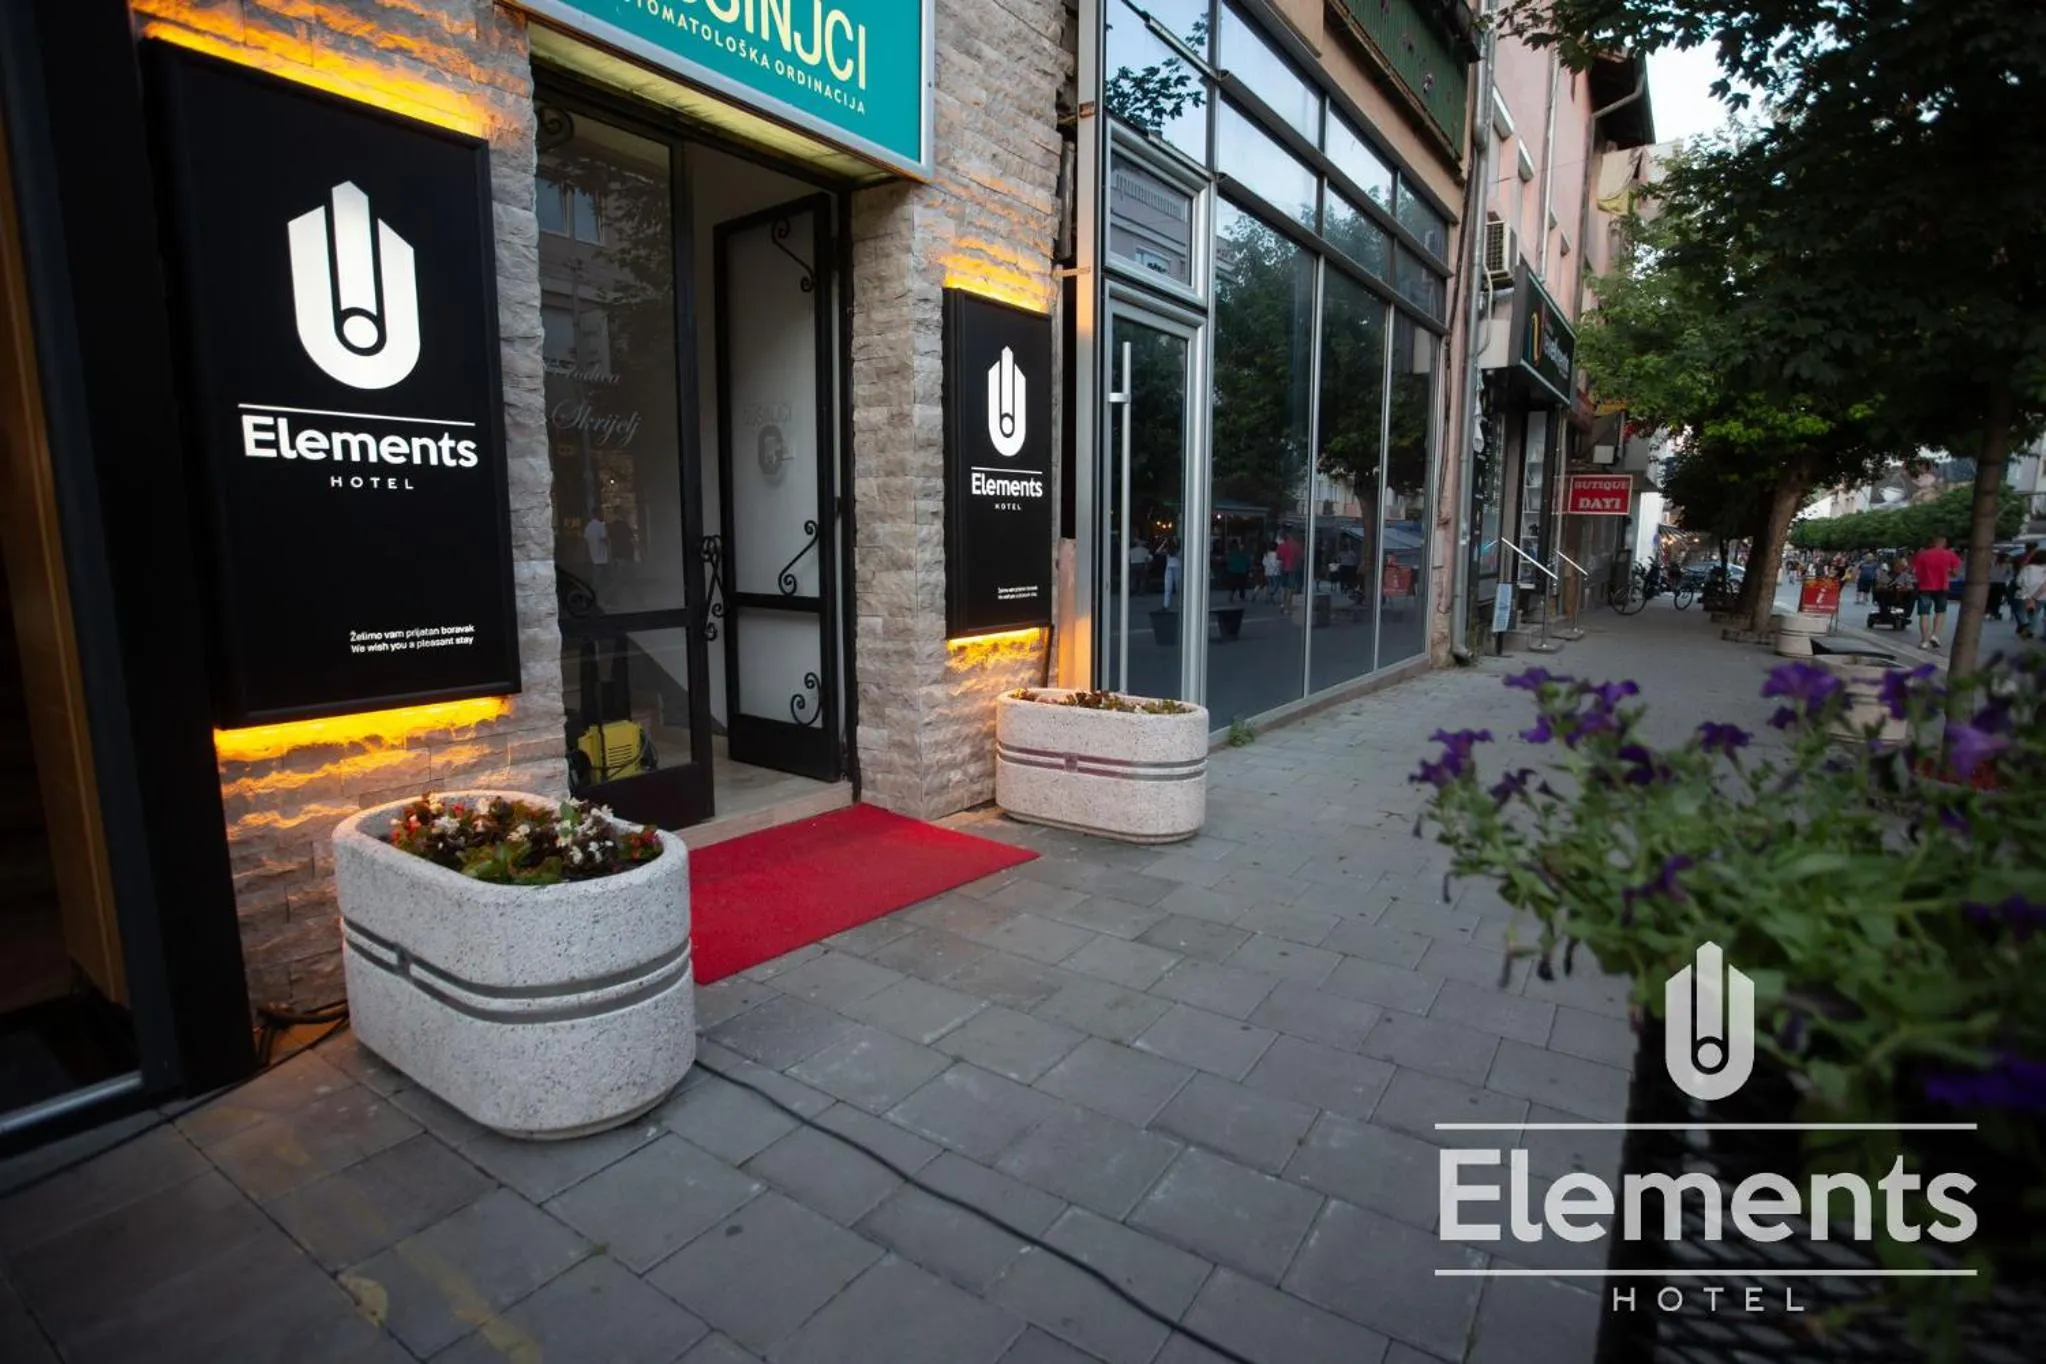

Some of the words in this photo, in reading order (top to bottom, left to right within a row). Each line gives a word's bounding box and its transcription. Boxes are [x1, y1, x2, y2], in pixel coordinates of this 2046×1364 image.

[624, 0, 770, 69] OMATOLOŠKA
[774, 60, 866, 115] ORDINACIJA
[681, 0, 866, 90] NJCI
[241, 414, 479, 468] Elements
[330, 476, 414, 490] HOTEL
[971, 472, 1043, 497] Elements
[384, 630, 404, 639] vam
[441, 624, 475, 635] boravak
[351, 644, 366, 653] We
[367, 642, 389, 651] wish
[390, 642, 407, 652] you
[409, 641, 415, 649] a
[416, 637, 454, 650] pleasant
[455, 636, 474, 646] stay
